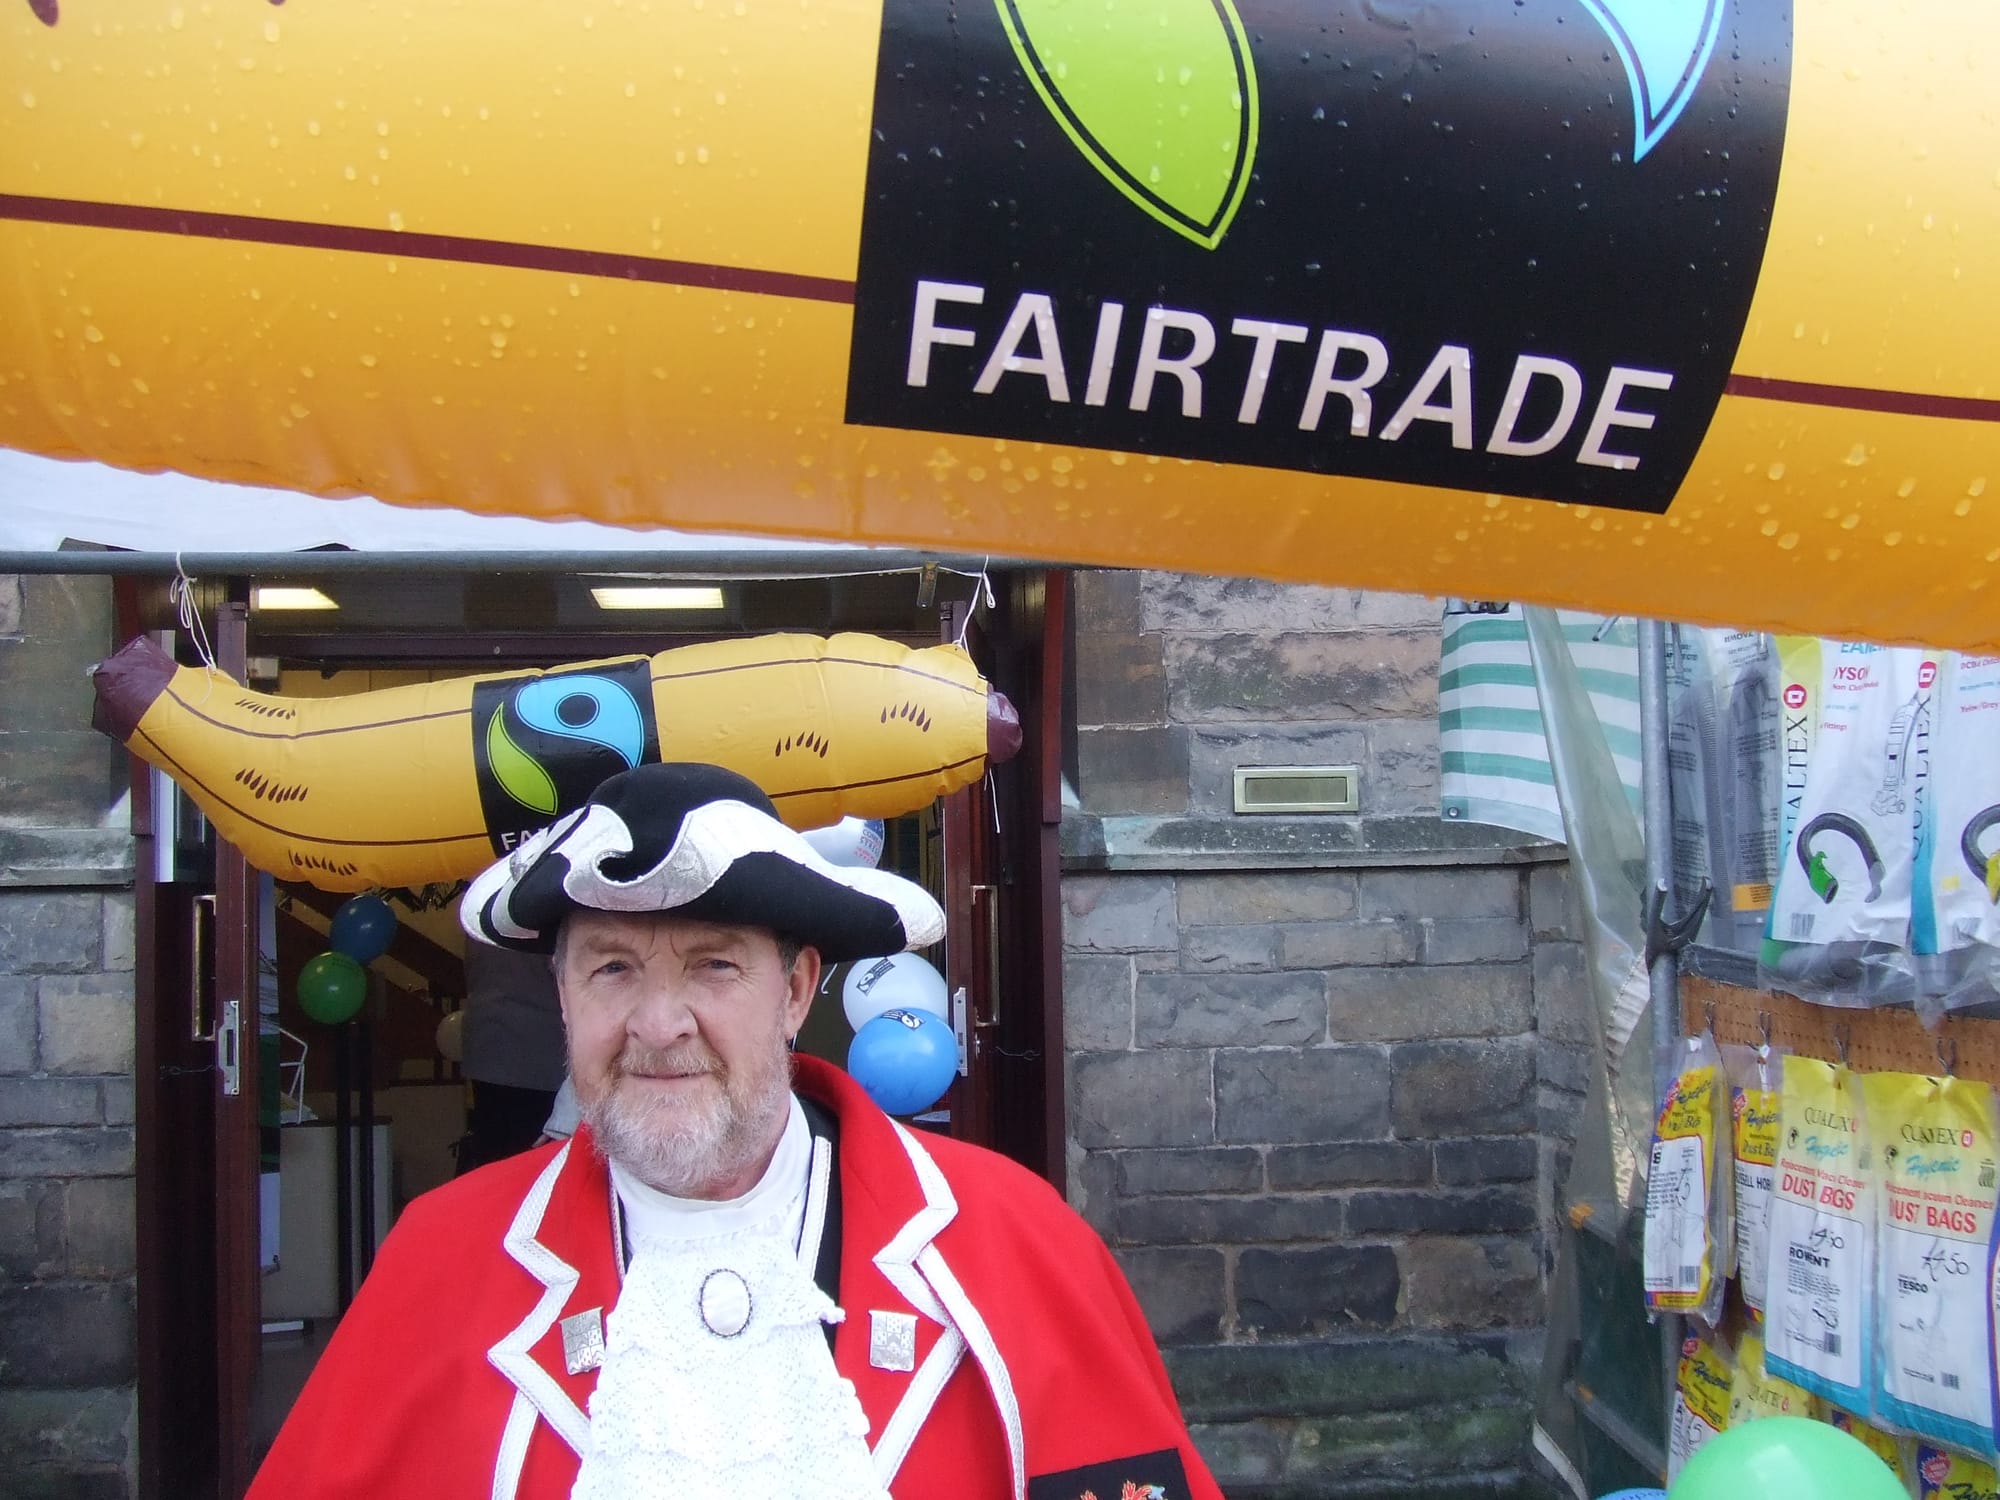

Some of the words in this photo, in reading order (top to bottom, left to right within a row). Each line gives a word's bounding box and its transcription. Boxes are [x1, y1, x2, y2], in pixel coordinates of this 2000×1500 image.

[906, 279, 1674, 472] FAIRTRADE
[1785, 715, 1808, 857] UALTEX
[501, 828, 545, 851] FA
[1926, 1205, 1978, 1234] BAGS
[1898, 1277, 1929, 1294] TESCO
